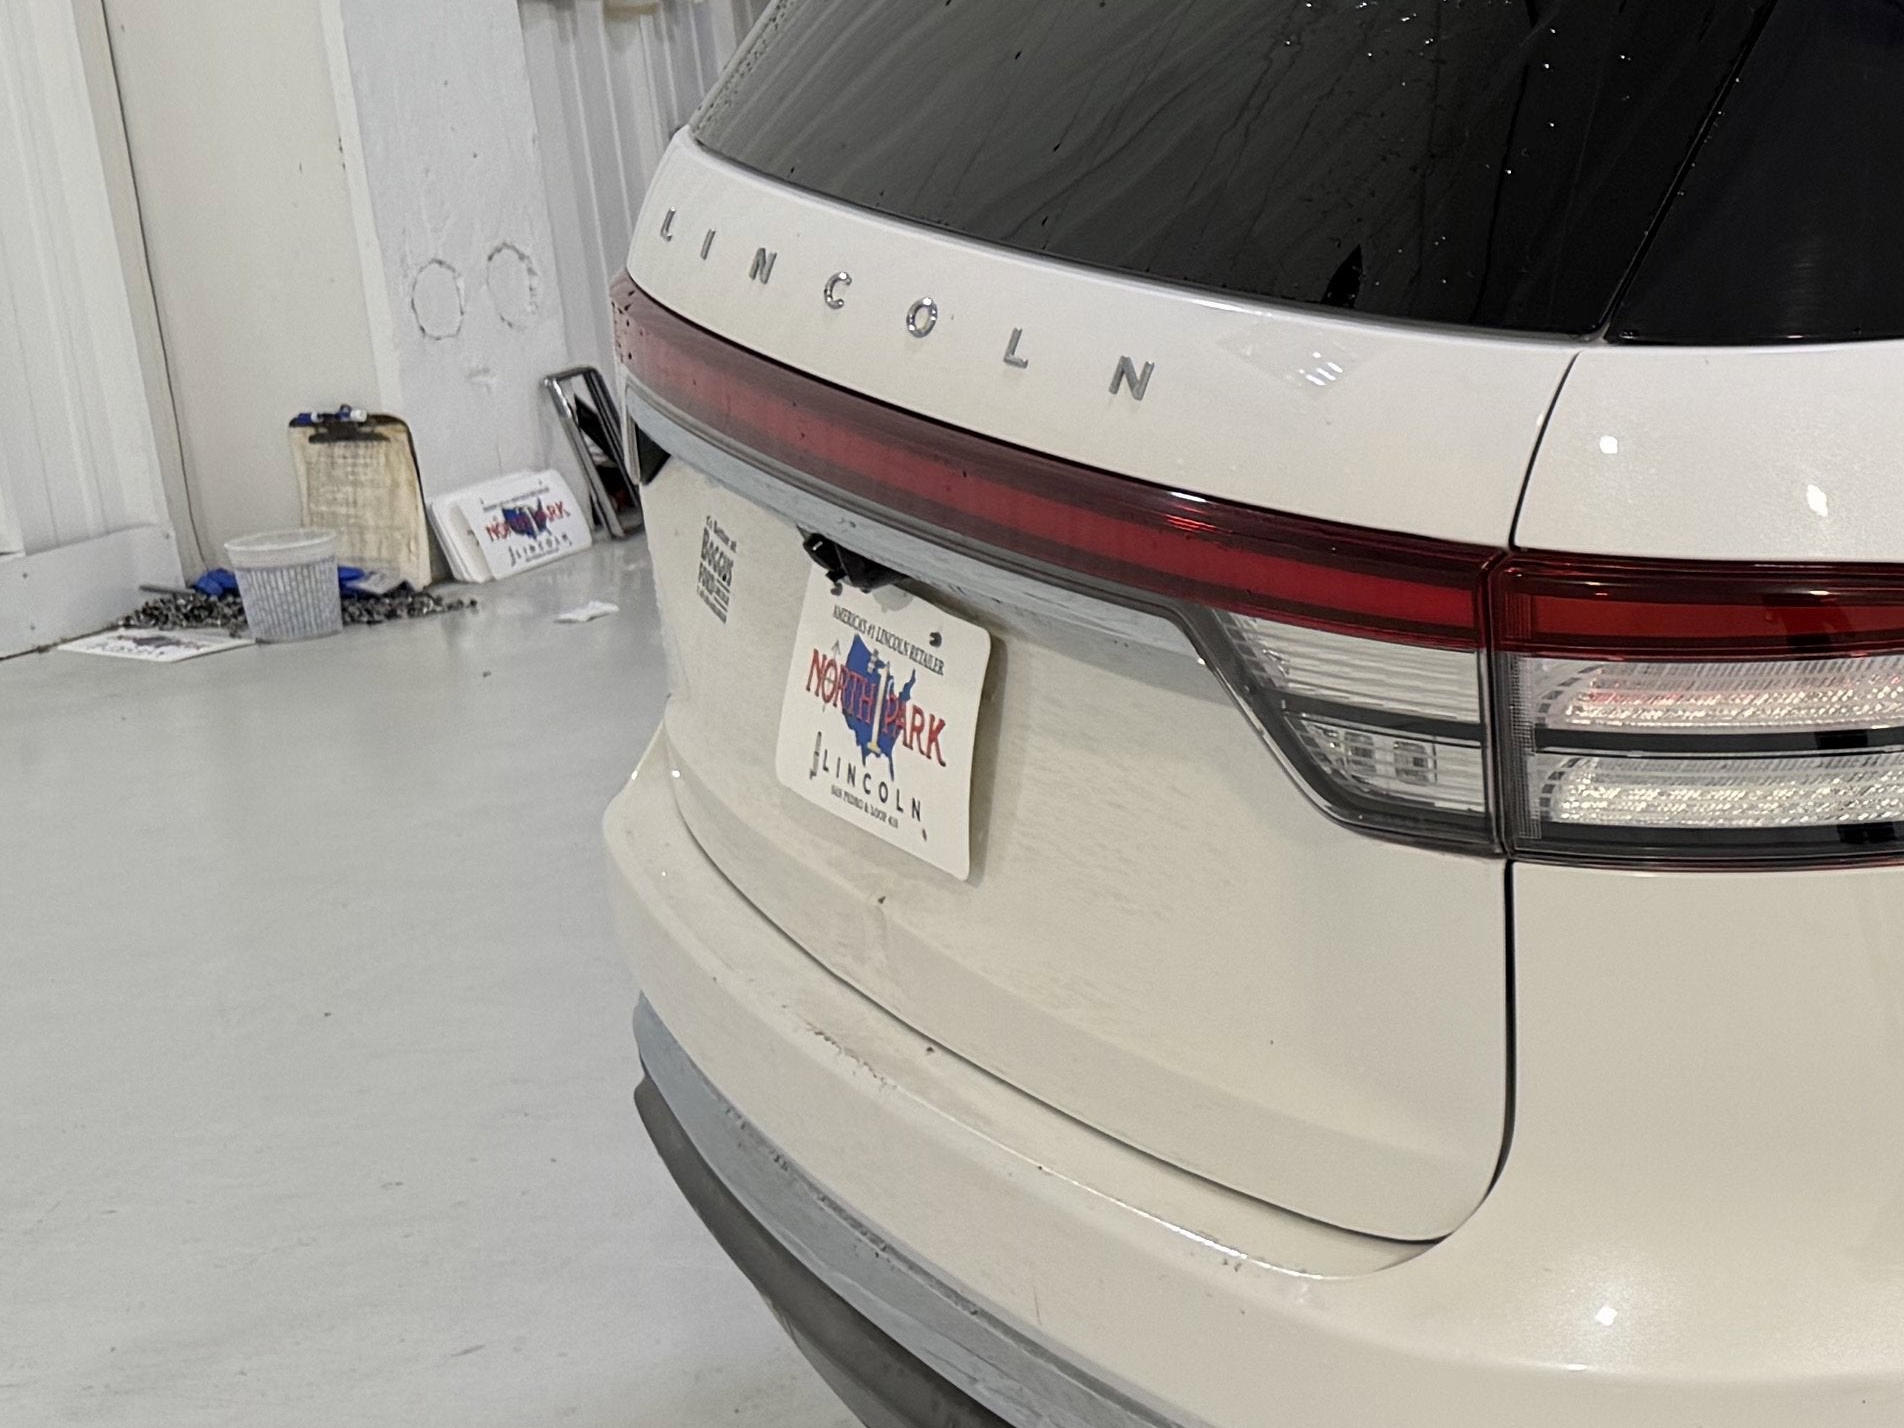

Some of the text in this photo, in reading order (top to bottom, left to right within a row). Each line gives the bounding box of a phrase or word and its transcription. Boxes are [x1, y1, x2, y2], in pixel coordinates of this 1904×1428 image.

[660, 206, 1155, 402] LINCOLN
[876, 626, 910, 657] LINCOLN
[909, 649, 945, 676] RETAILER
[805, 649, 947, 767] NORTH PARK
[822, 749, 922, 822] LINCOLN
